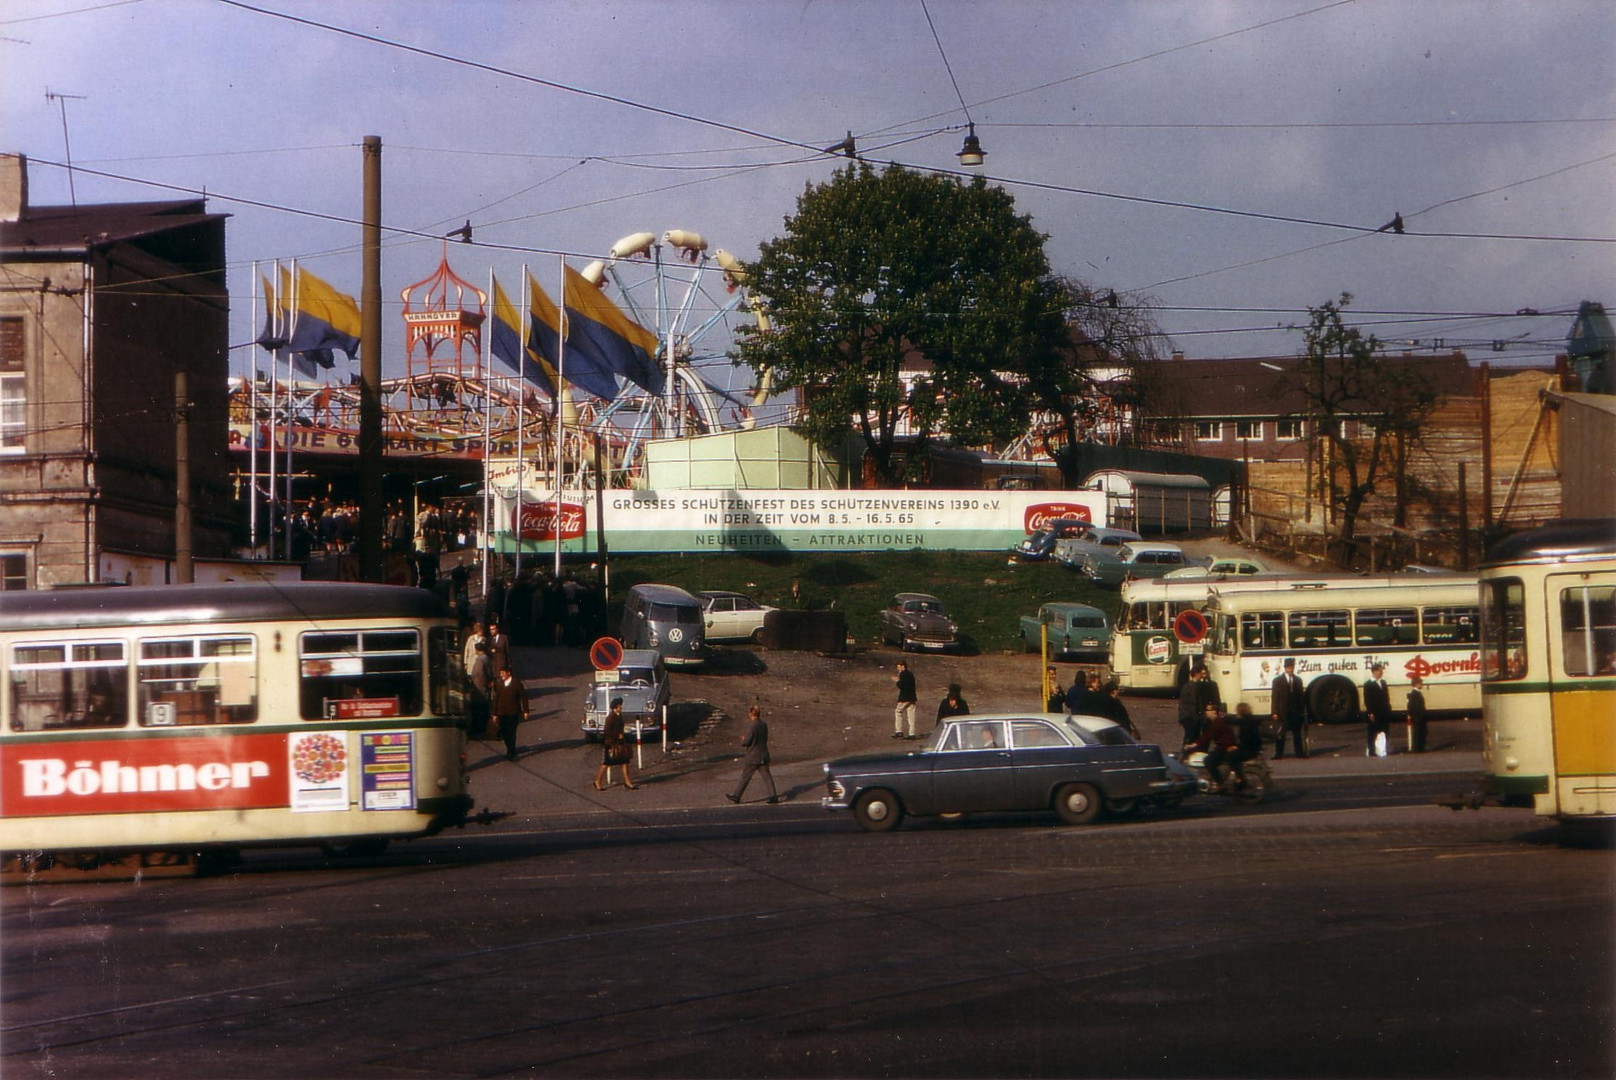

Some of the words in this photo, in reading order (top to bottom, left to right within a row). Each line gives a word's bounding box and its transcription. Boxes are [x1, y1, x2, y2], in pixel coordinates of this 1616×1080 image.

[408, 312, 457, 321] HANNOVER
[284, 431, 326, 447] DIE
[613, 499, 676, 510] GROSSES
[682, 497, 785, 510] SCHÜTZENFEST
[790, 499, 815, 510] DES
[821, 497, 945, 510] SCHÜTZENVEREINS
[950, 500, 979, 510] 1390
[983, 500, 1000, 510] e.V.
[704, 513, 718, 524] IN
[724, 513, 750, 524] DER
[756, 513, 784, 524] ZEIT
[790, 513, 820, 524] VOM
[695, 534, 782, 545] NEUHEITEN
[809, 534, 924, 545] ATTRAKTIONEN
[1297, 659, 1322, 674] Zum
[1327, 658, 1358, 673] guten
[18, 758, 270, 797] Böhmer
